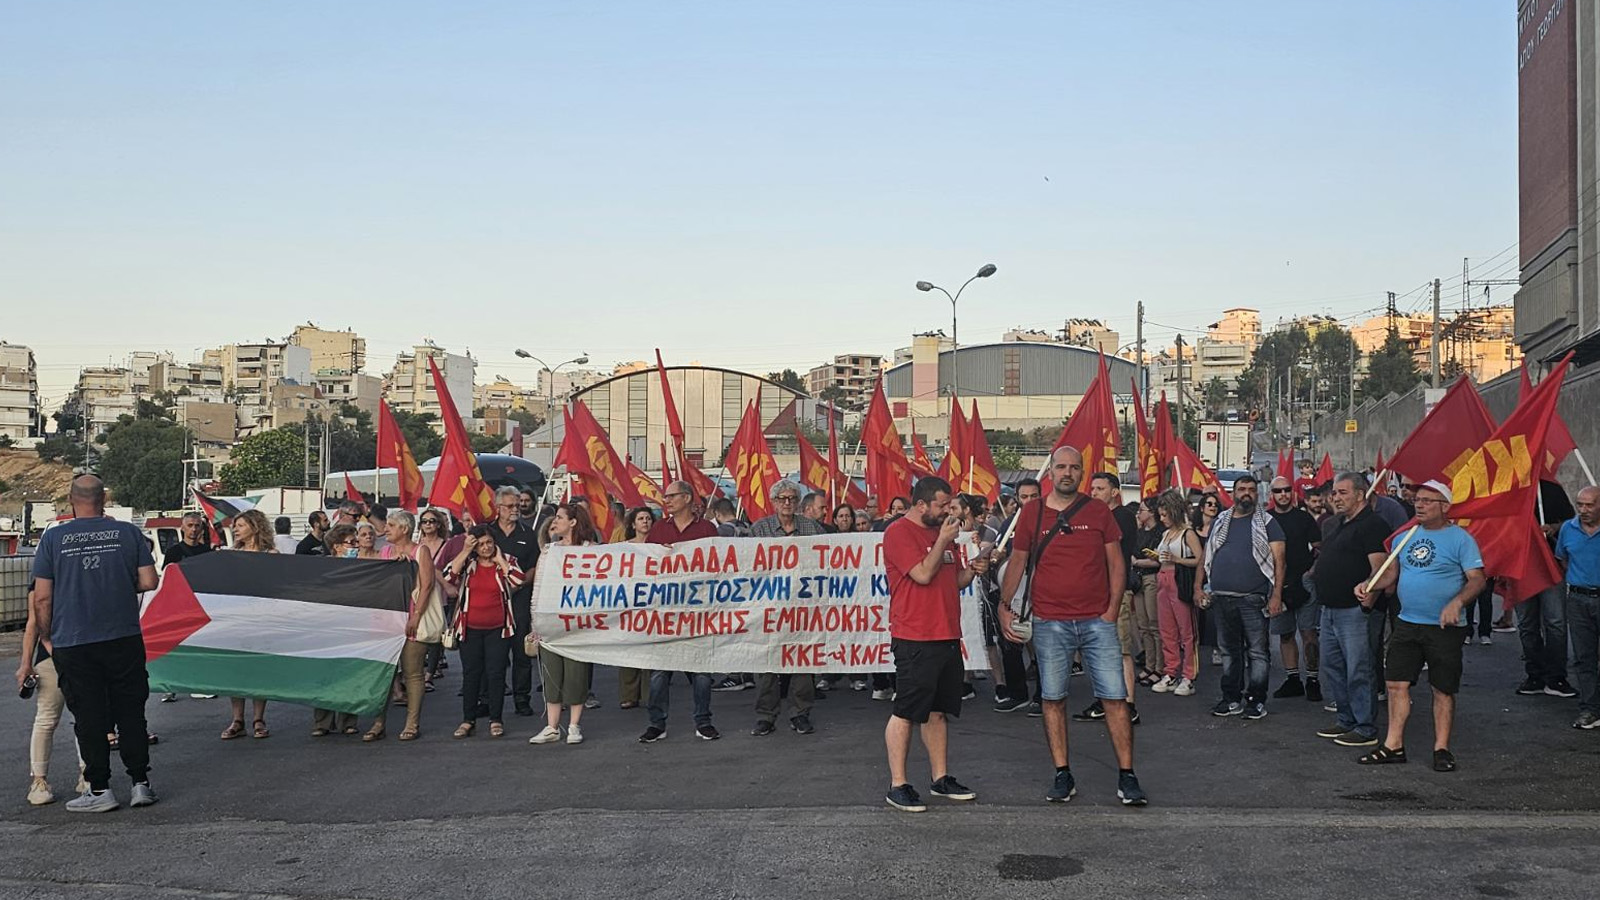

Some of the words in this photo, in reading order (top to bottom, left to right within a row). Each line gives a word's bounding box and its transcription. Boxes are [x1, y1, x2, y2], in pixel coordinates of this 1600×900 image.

[82, 555, 100, 569] 92
[562, 552, 613, 579] ΕΞΩ
[619, 552, 636, 577] Η
[645, 544, 739, 576] ΕΛΛΑΔΑ
[752, 542, 799, 572] ΑΠΟ
[812, 544, 863, 570] ΤΟΝ
[560, 583, 629, 609] ΚΑΜΙΑ
[633, 575, 791, 608] ΕΜΠΙΣΤΟΣΥΝΗ
[797, 574, 858, 599] ΣΤΗΝ
[558, 613, 610, 632] ΤΗΣ
[619, 609, 750, 638] ΠΟΛΕΜΙΚΗΣ
[781, 643, 827, 668] ΚΚΕ
[849, 643, 891, 667] ΚΝΕ
